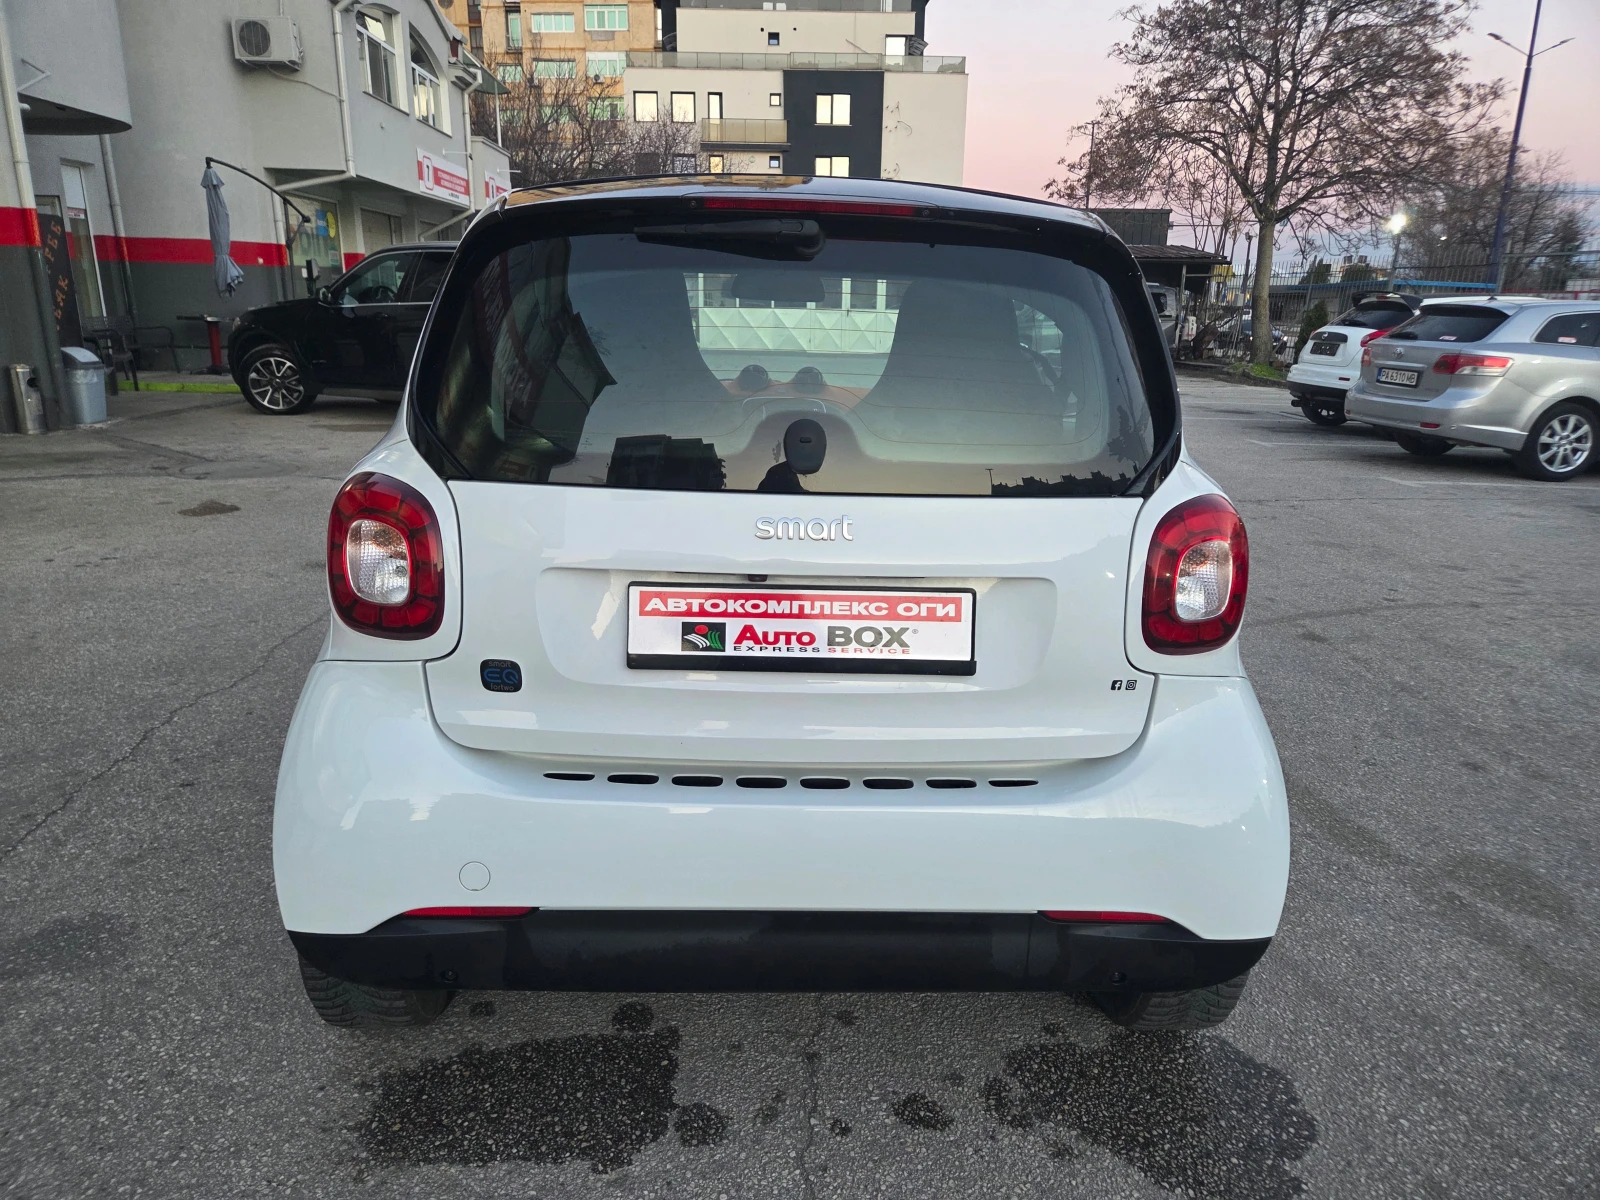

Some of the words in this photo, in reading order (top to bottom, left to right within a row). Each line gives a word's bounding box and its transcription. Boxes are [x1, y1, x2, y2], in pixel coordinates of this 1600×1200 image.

[755, 514, 854, 541] smart
[644, 597, 889, 617] АВТОКОМПЛЕКС
[896, 602, 956, 618] ОГИ
[733, 645, 821, 653] EXPRESS
[827, 647, 911, 655] SERVICE
[483, 667, 519, 684] EQ
[490, 683, 514, 691] fortwo
